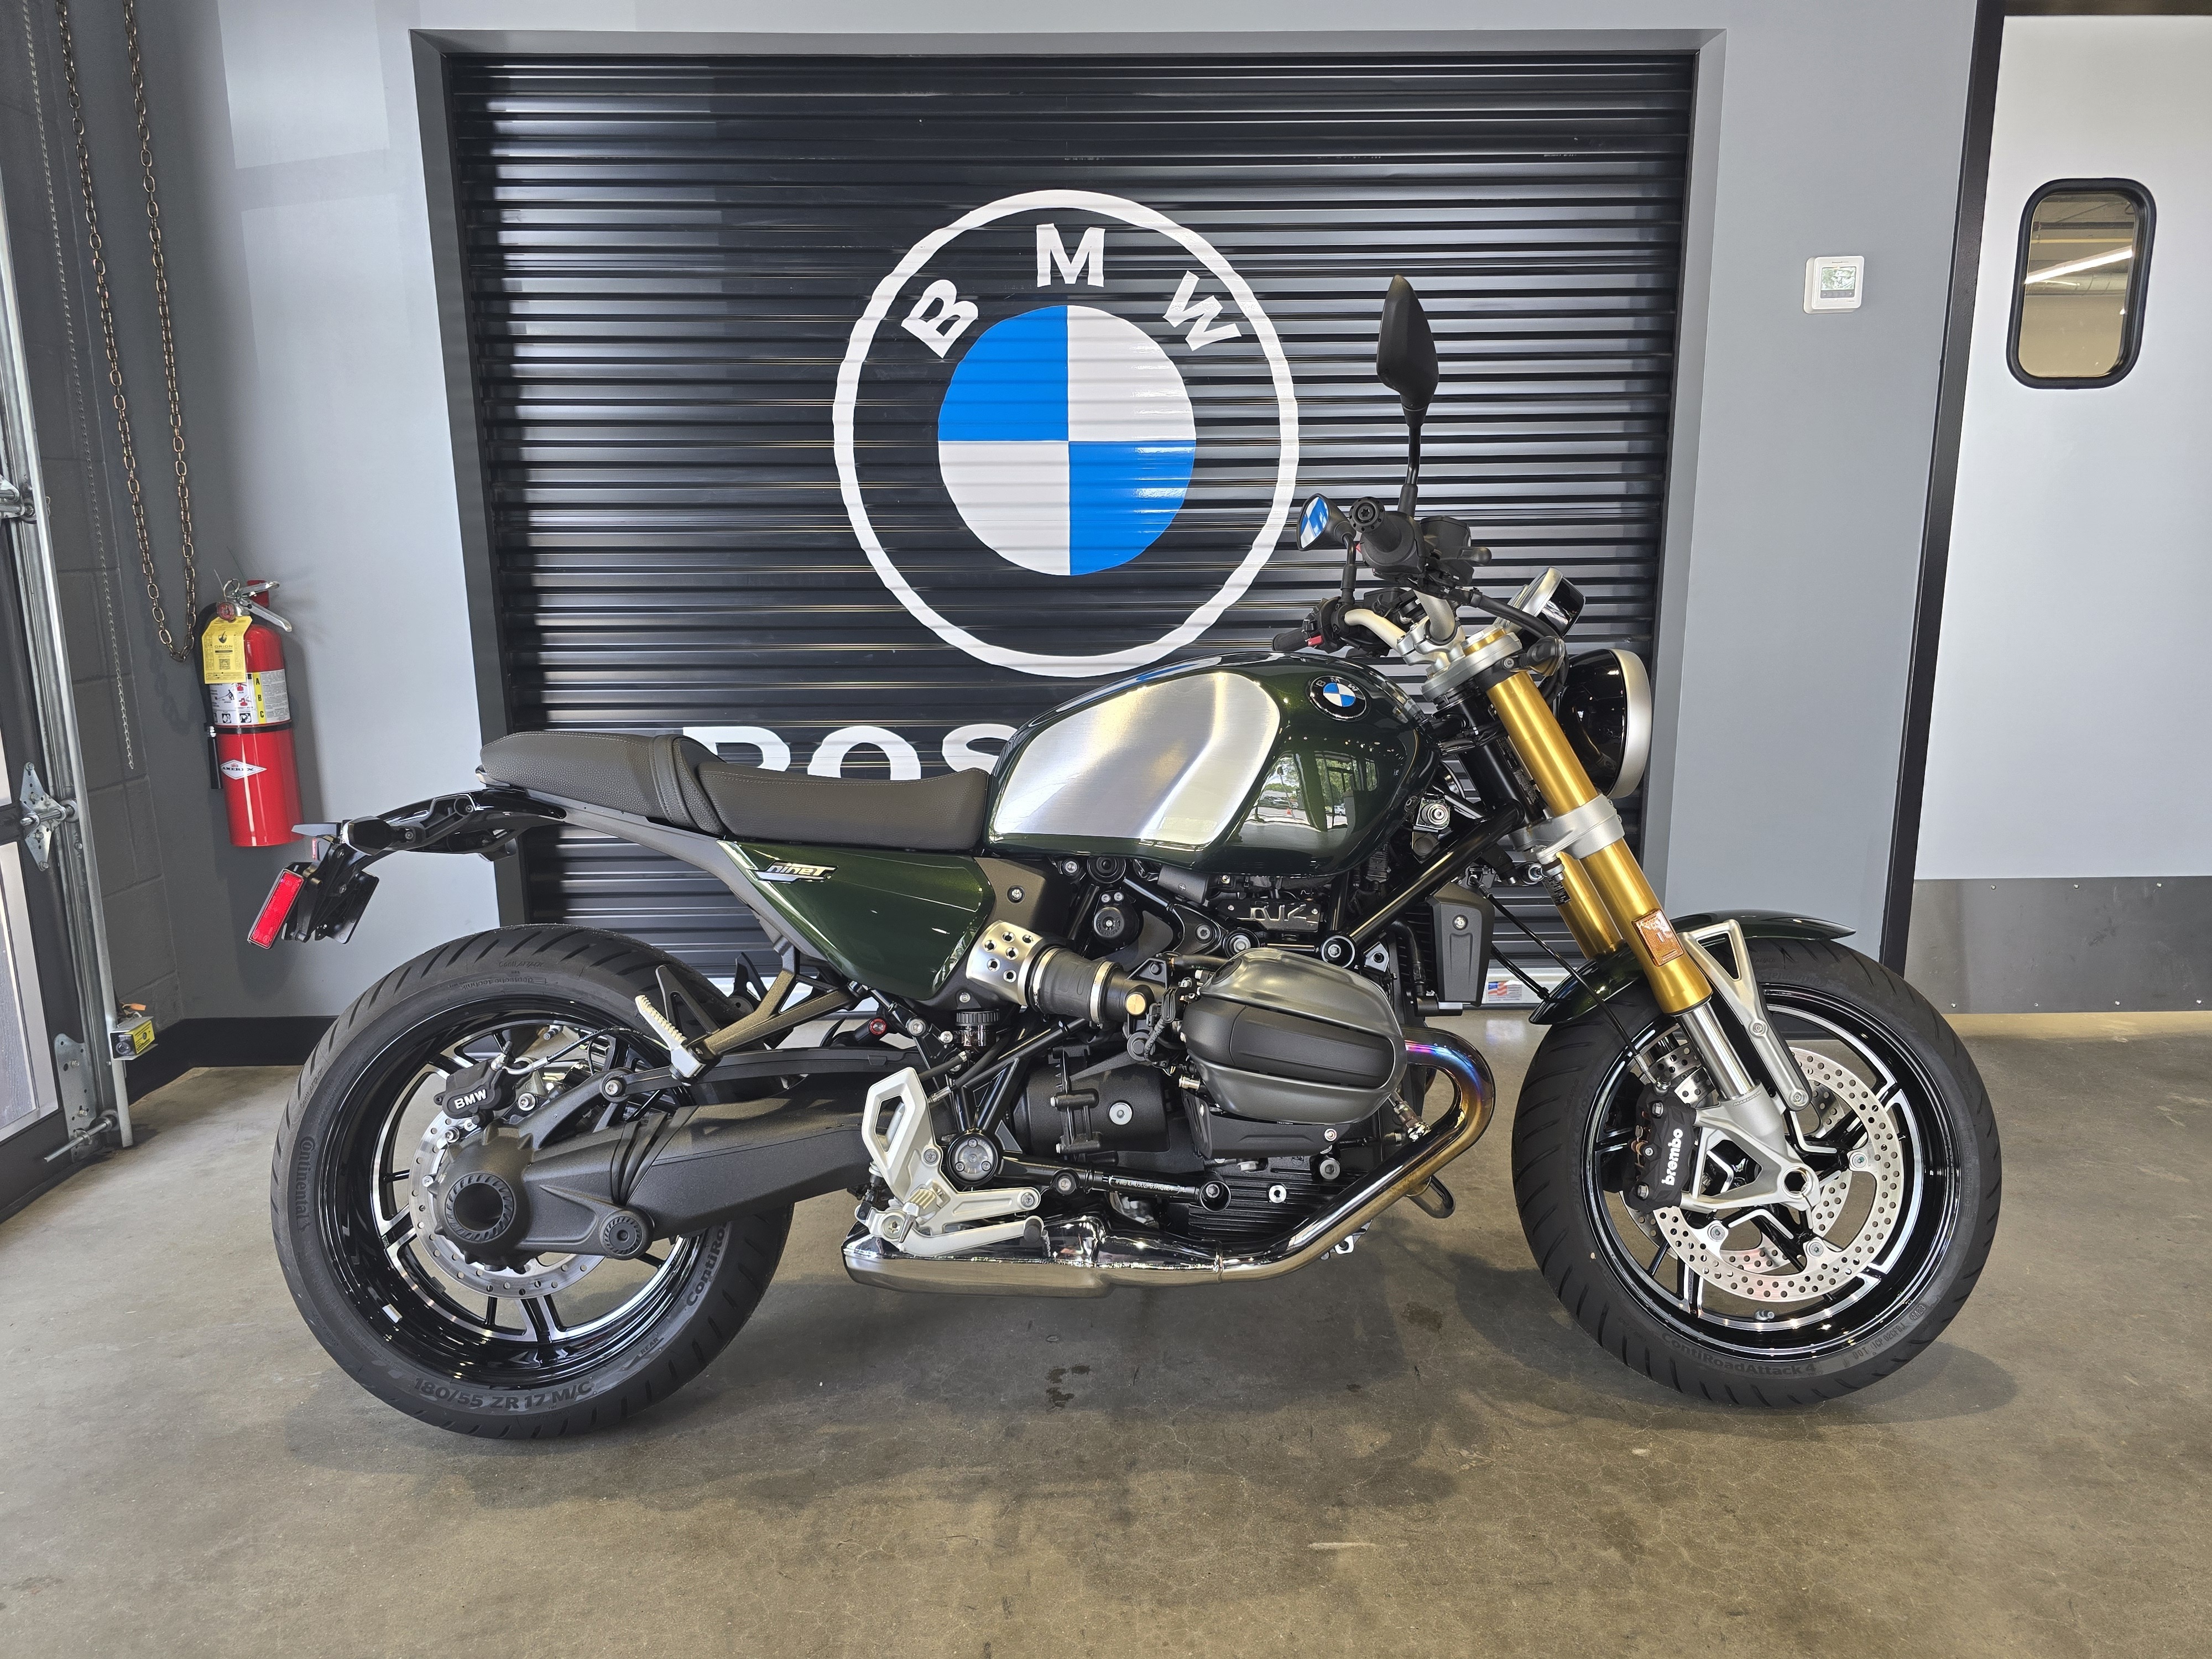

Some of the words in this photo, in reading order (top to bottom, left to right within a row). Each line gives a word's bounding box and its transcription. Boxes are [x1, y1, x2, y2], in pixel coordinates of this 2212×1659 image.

[901, 222, 1243, 358] BMW
[1316, 677, 1359, 692] BMW
[453, 1089, 487, 1109] BMW
[1661, 1128, 1683, 1186] brembo
[295, 1136, 316, 1220] Continental
[640, 1337, 660, 1355] REAR
[413, 1377, 484, 1408] 180/55
[489, 1395, 520, 1410] ZR
[523, 1394, 545, 1408] 17
[552, 1380, 593, 1405] M/C
